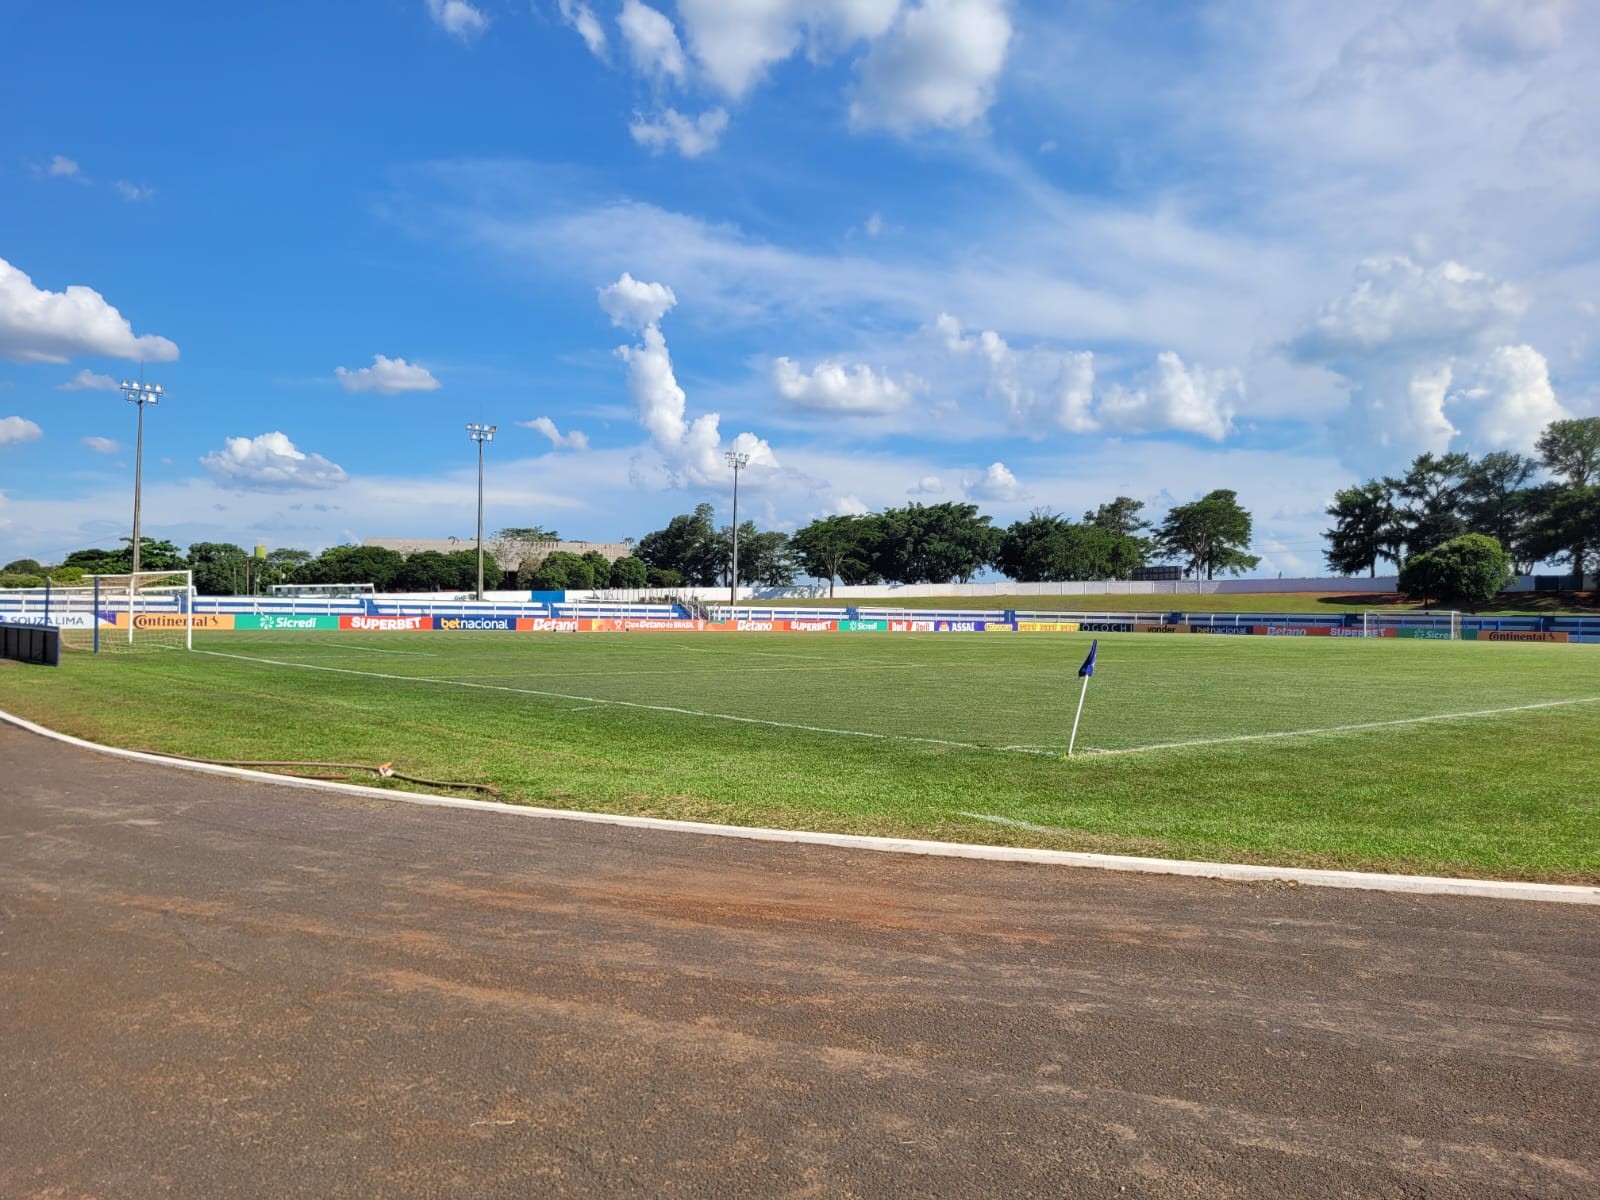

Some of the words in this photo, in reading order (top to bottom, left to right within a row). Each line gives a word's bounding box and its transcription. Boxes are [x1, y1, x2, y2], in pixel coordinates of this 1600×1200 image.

[55, 616, 84, 625] LIMA
[276, 617, 316, 629] Sicredi
[351, 616, 421, 630] SUPERBET
[440, 617, 509, 630] betnacional
[533, 618, 577, 631] Betano
[737, 620, 772, 632] Betano
[790, 621, 832, 631] SUPERBET
[1082, 624, 1134, 632] OGOCHI
[1146, 624, 1176, 633] vonder
[1266, 626, 1308, 636] Betano
[1330, 628, 1386, 638] SUPERBET
[1488, 631, 1546, 641] Continental
